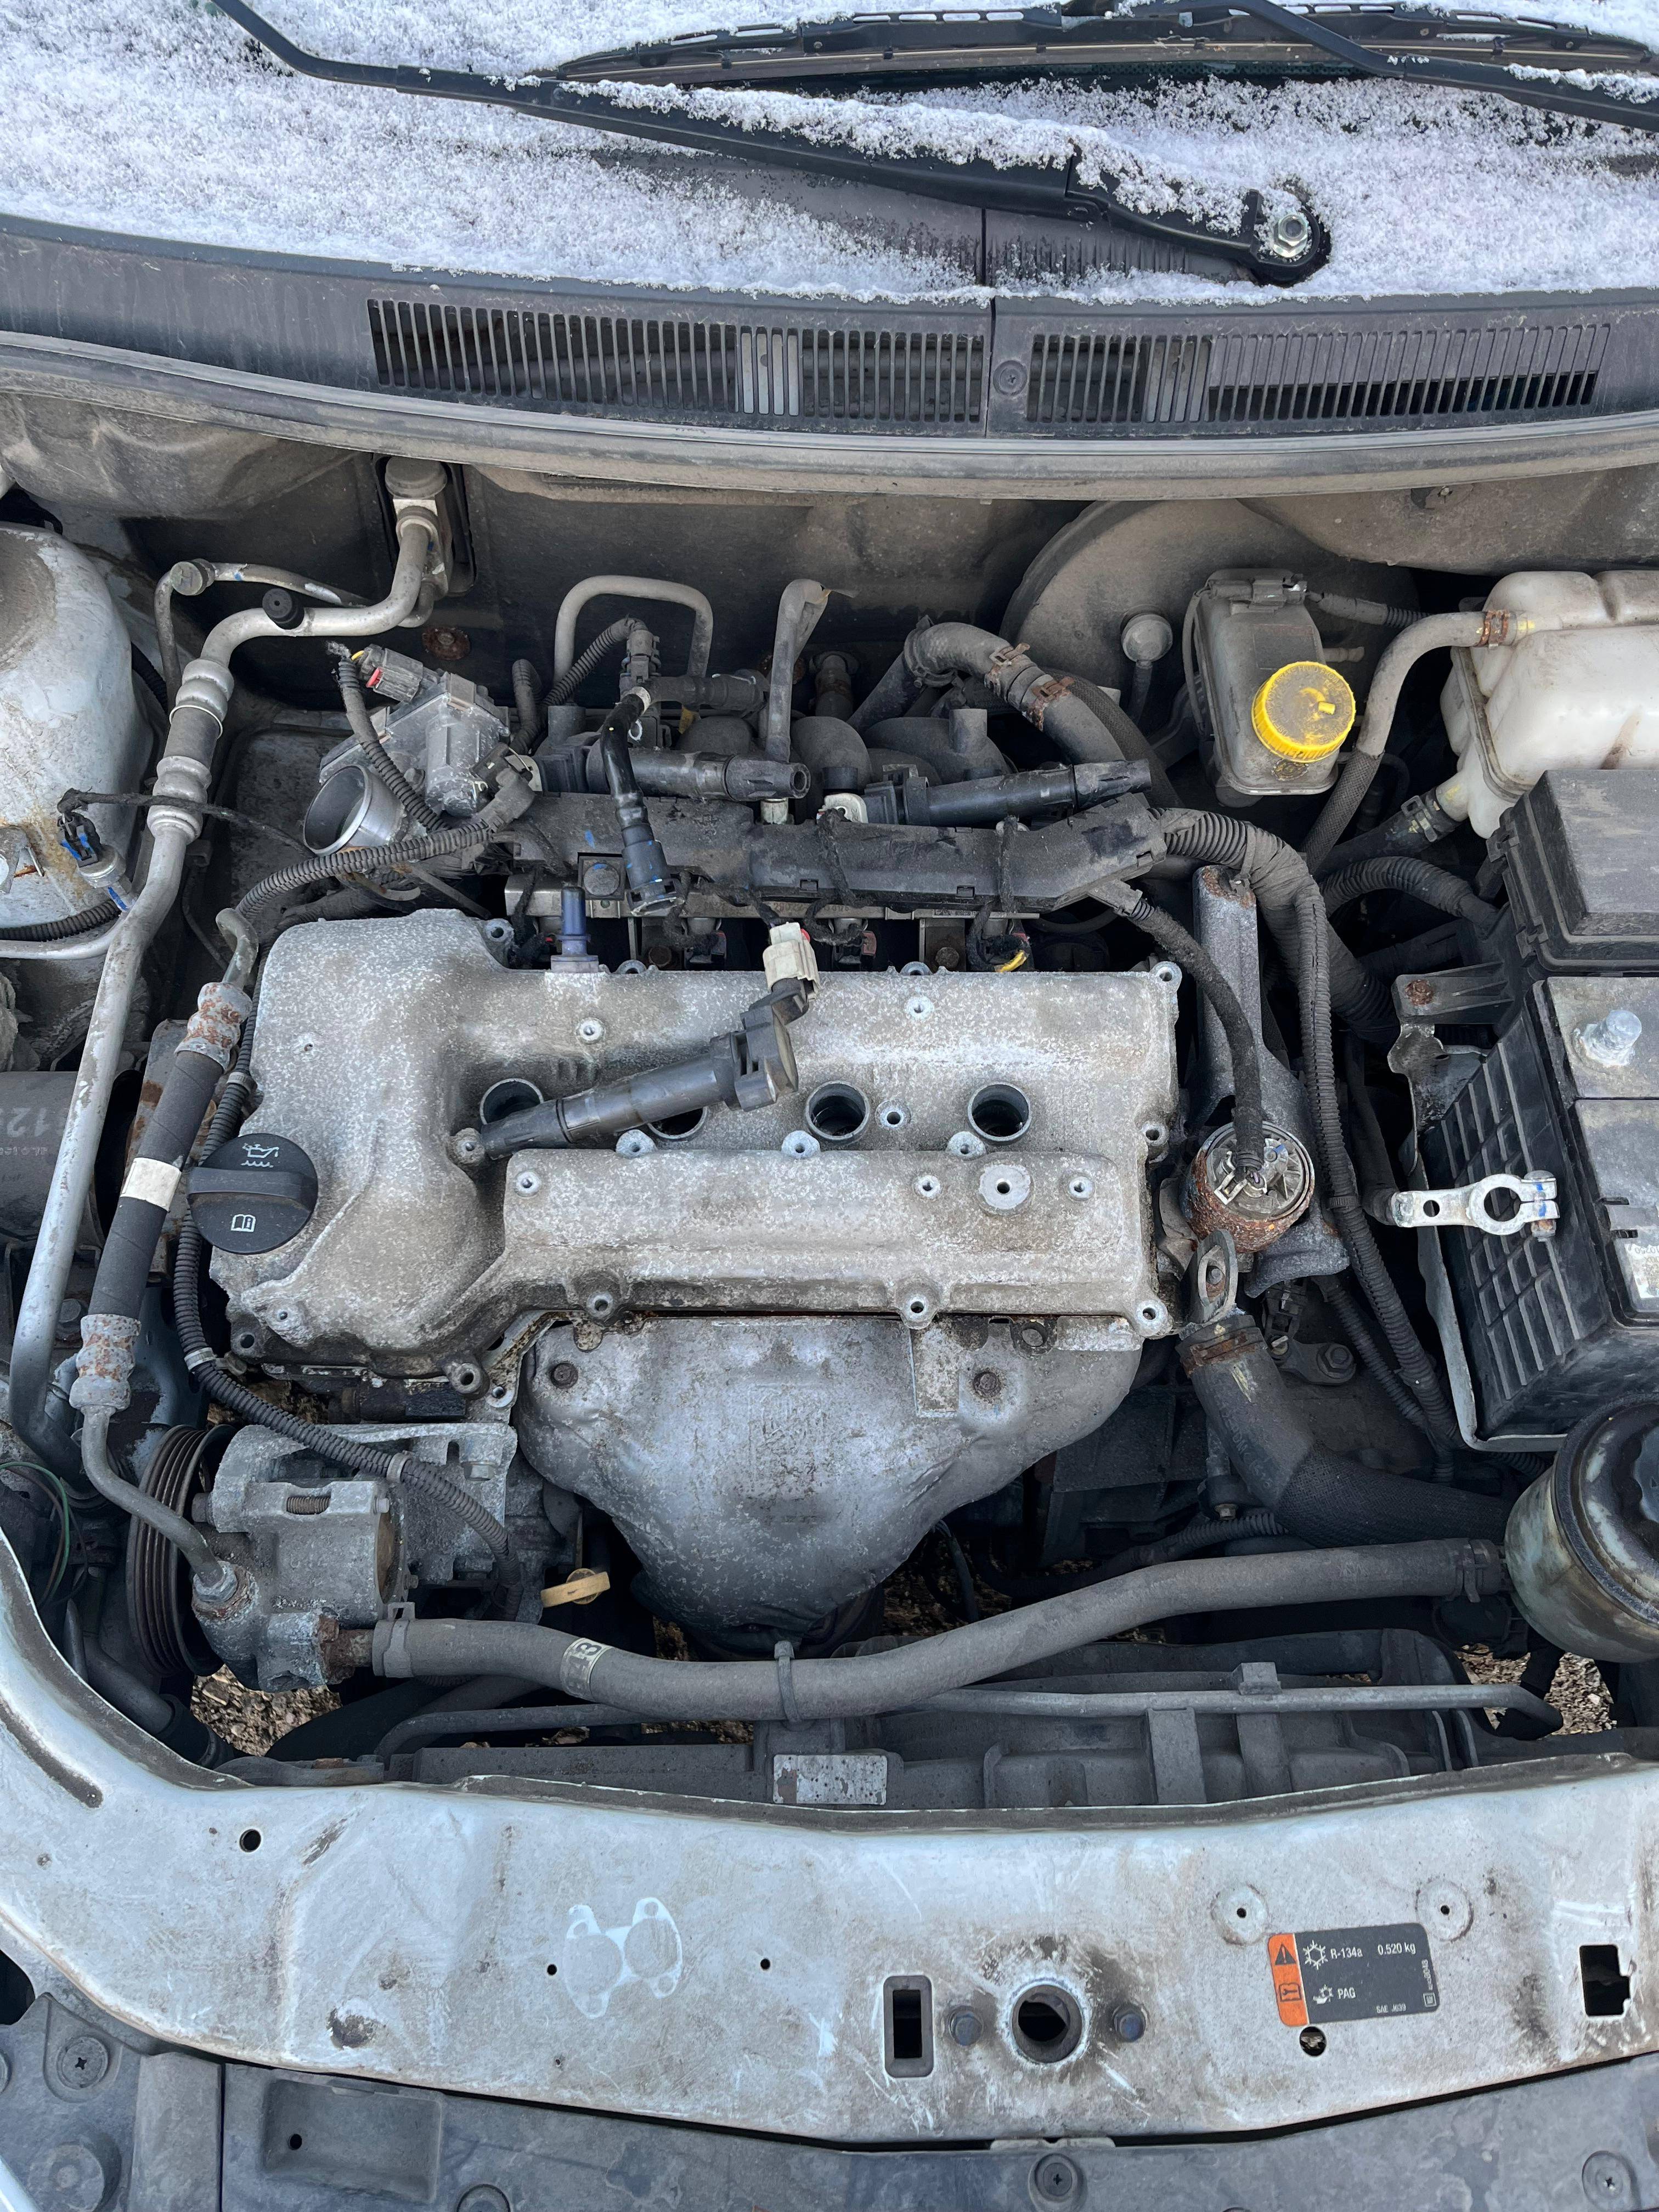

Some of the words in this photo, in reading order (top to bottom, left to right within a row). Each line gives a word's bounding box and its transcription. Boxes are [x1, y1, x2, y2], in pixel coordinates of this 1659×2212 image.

[1330, 1947, 1363, 1959] R-134a
[1378, 1943, 1402, 1956] 0.520
[1404, 1942, 1417, 1955] kg
[1338, 1987, 1356, 2000] PAG
